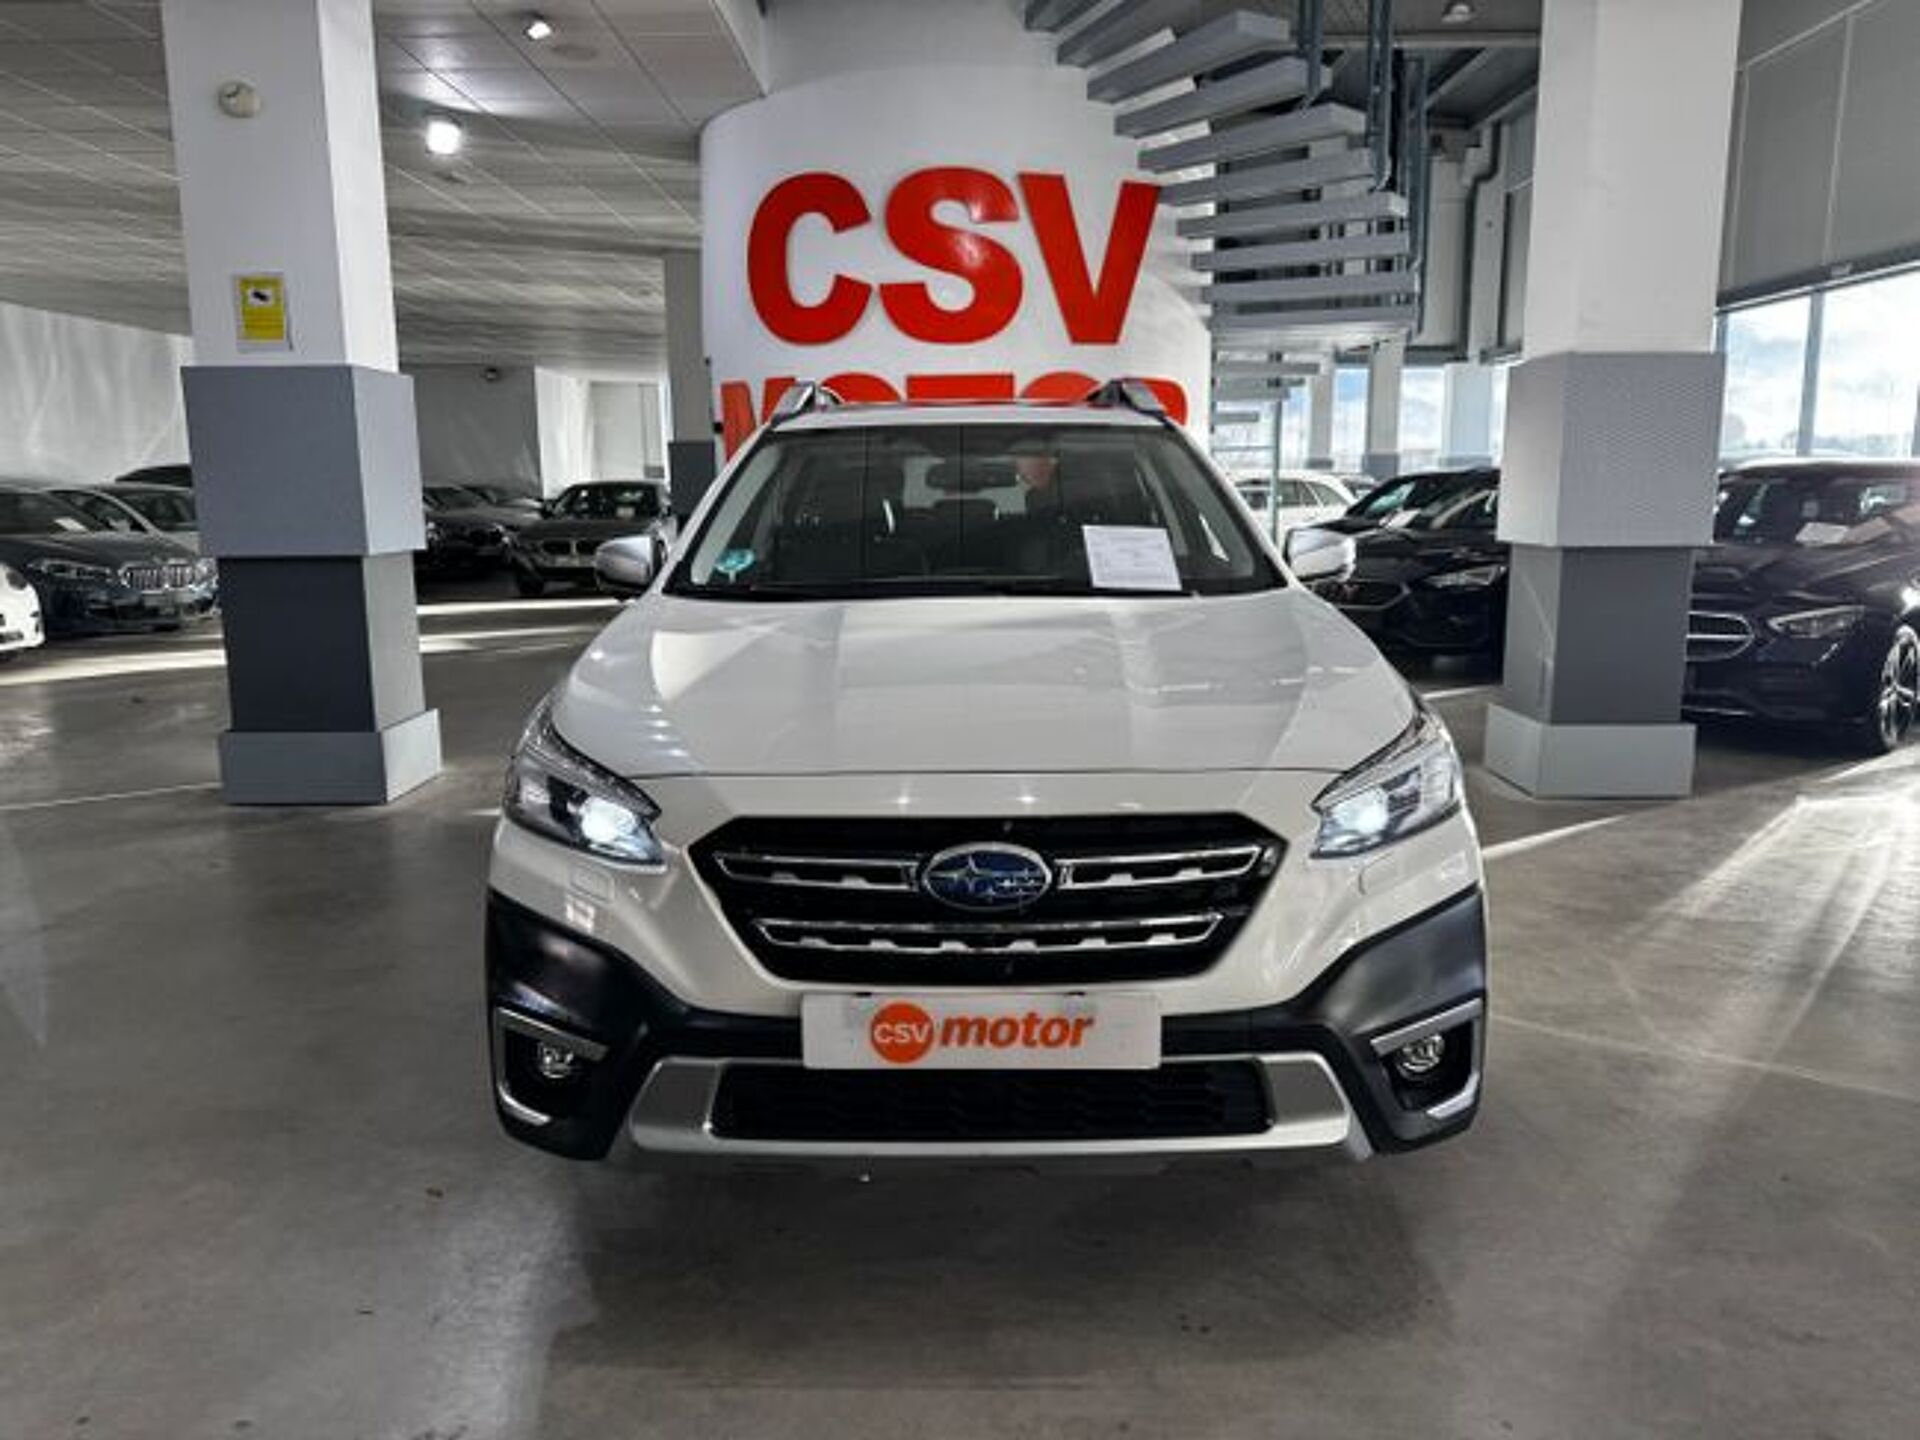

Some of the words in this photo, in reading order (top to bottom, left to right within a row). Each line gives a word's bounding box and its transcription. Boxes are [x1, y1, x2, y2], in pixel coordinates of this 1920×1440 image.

[747, 166, 1162, 346] CSV
[873, 1021, 931, 1045] CSV
[940, 1012, 1093, 1048] motor
